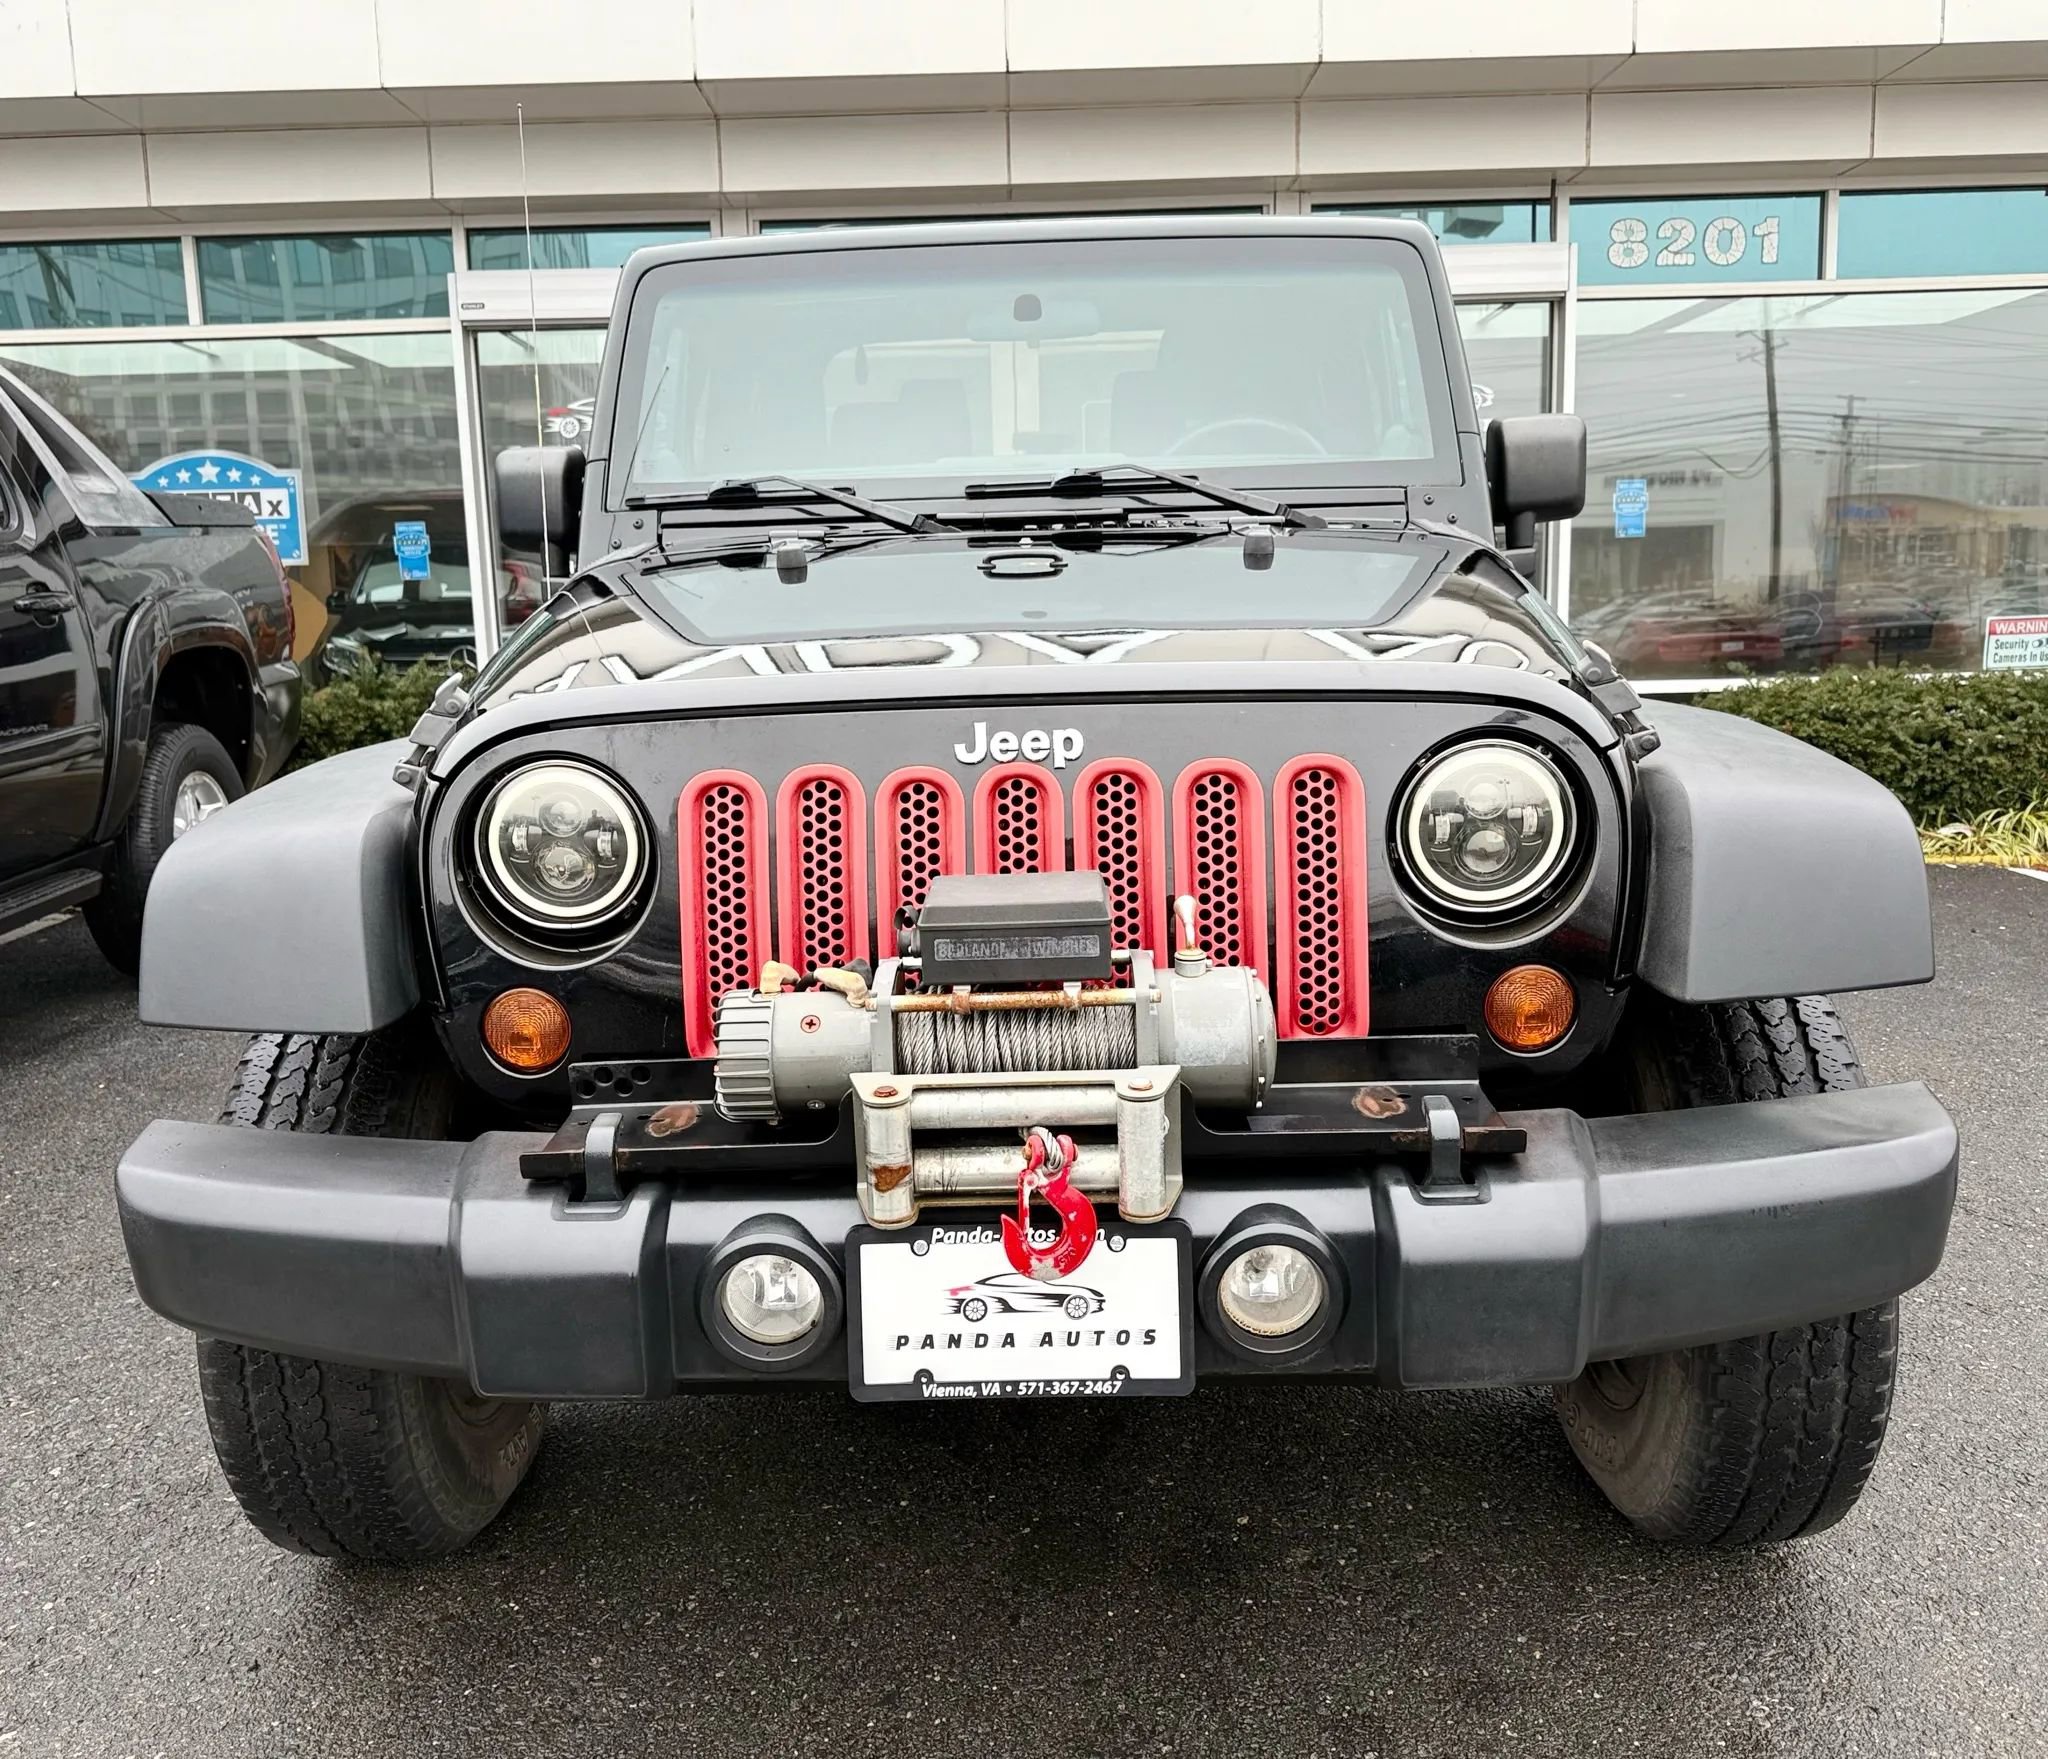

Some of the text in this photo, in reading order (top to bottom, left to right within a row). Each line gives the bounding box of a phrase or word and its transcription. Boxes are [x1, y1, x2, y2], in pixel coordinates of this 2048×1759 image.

[1607, 216, 1780, 269] 8201
[1994, 638, 2029, 651] Security
[1993, 652, 2027, 663] Cameras
[2029, 651, 2038, 662] In
[953, 721, 1084, 769] Jeep
[896, 1329, 1156, 1350] PANDA AUTOS
[921, 1380, 1123, 1399] Vienna, VA 571-367-2467
